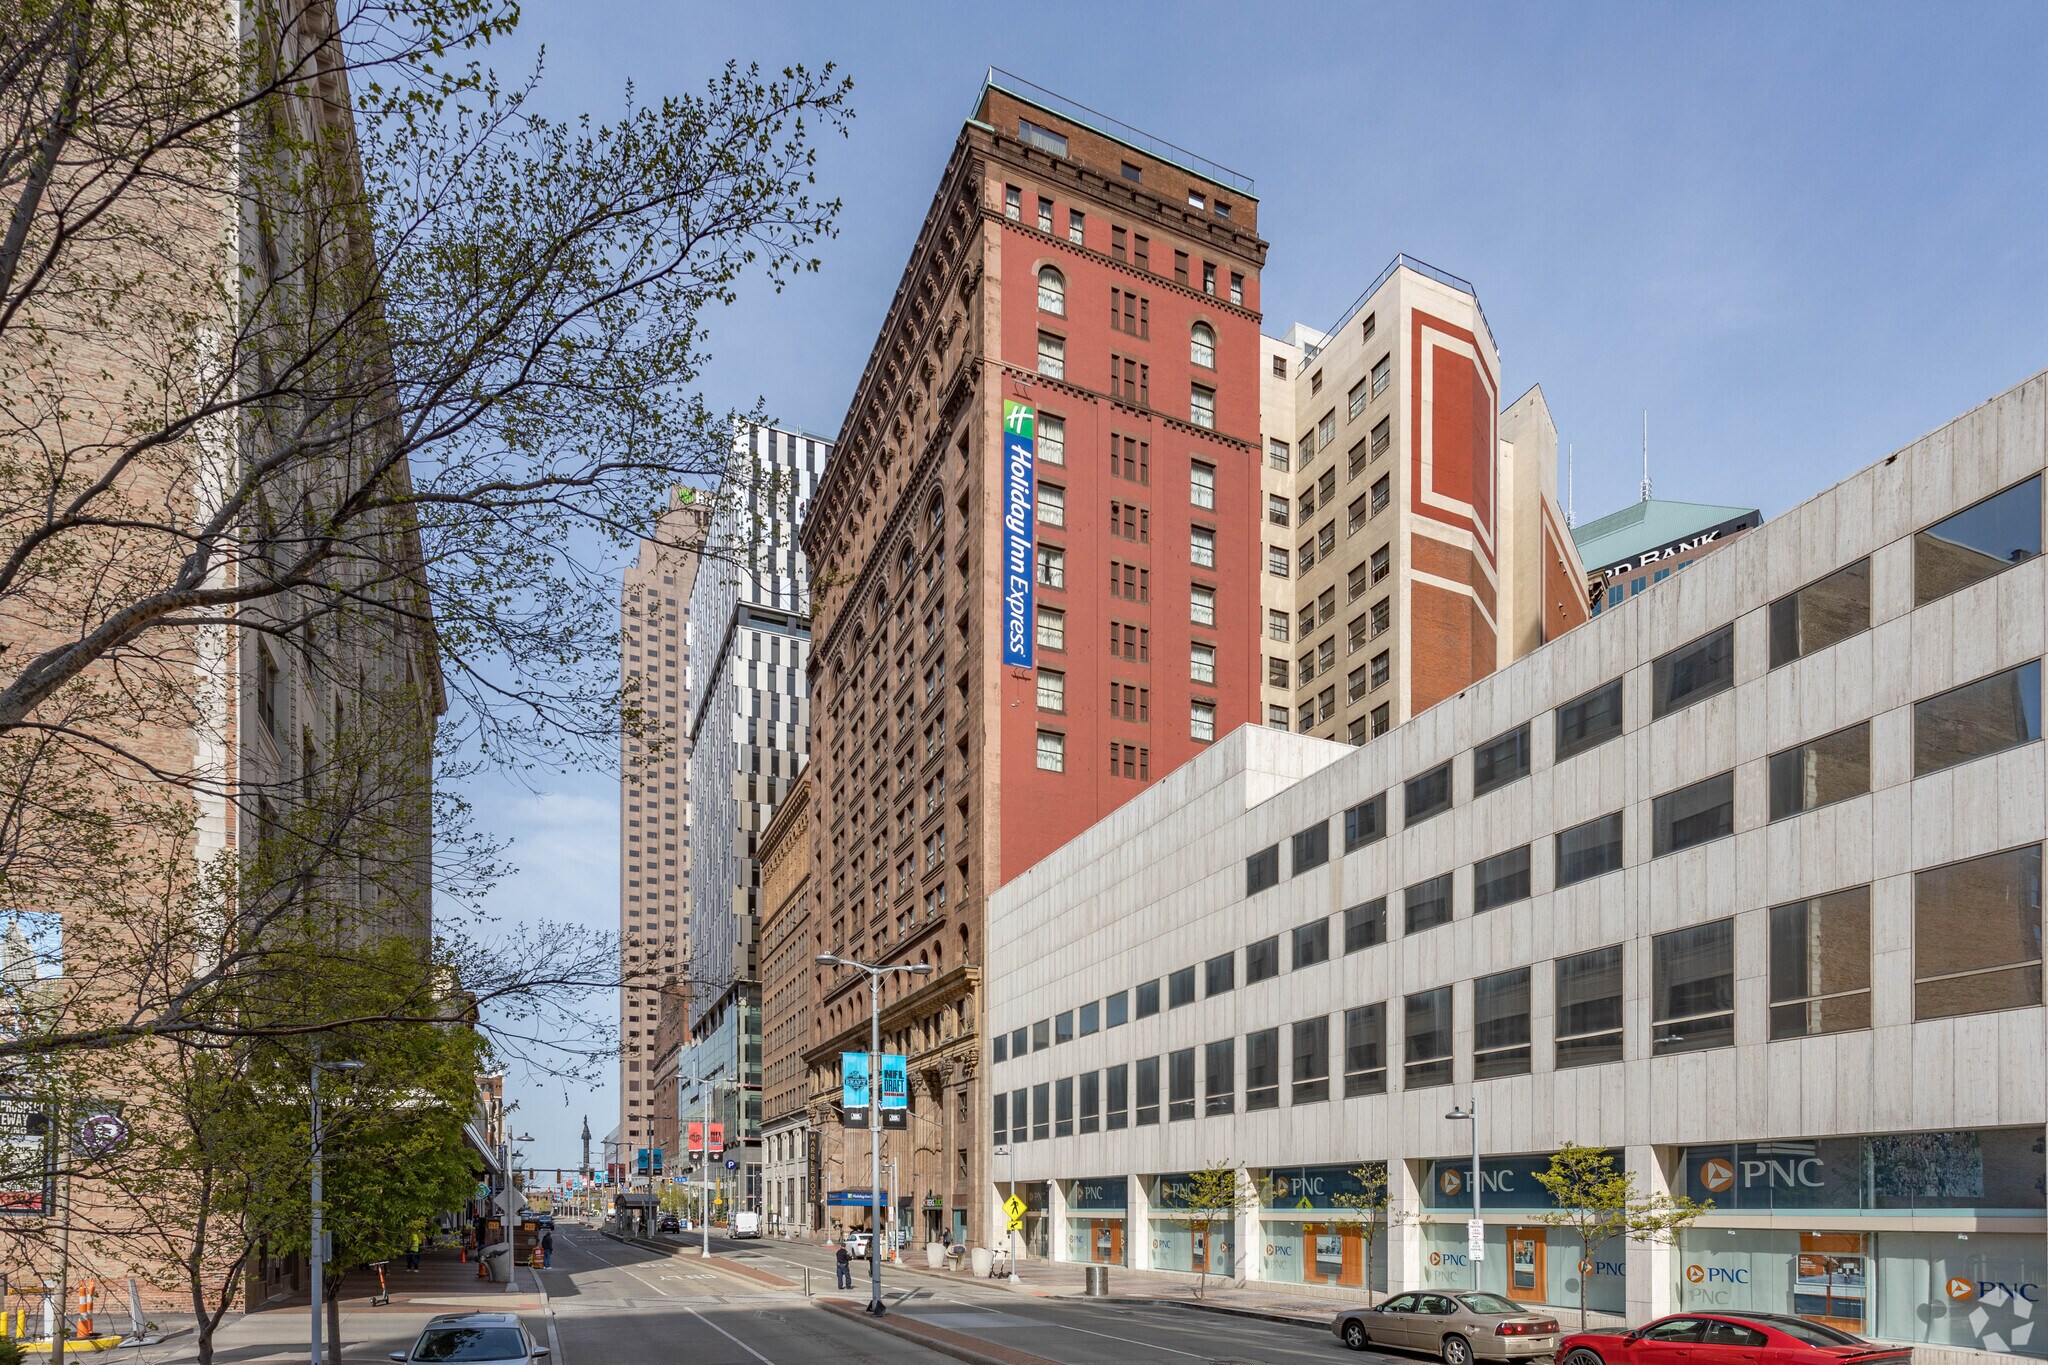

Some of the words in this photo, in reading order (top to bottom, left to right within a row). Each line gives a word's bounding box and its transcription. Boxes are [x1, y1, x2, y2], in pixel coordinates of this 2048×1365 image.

[1006, 445, 1032, 538] Holiday
[1011, 535, 1031, 573] Inn
[1005, 575, 1028, 657] Express
[884, 1070, 904, 1079] NFL
[884, 1079, 904, 1092] DRAFT
[1, 1100, 45, 1114] PROSPECT
[1740, 1158, 1825, 1188] PNC
[1291, 1177, 1325, 1196] PNC
[1463, 1170, 1514, 1192] PNC
[1085, 1186, 1103, 1200] PNC
[1172, 1183, 1195, 1198] PNC
[1159, 1240, 1171, 1248] PNC
[1275, 1245, 1291, 1256] PNC
[1443, 1254, 1467, 1266] PNC
[1707, 1267, 1748, 1283] PNC
[1977, 1281, 2039, 1302] PNC
